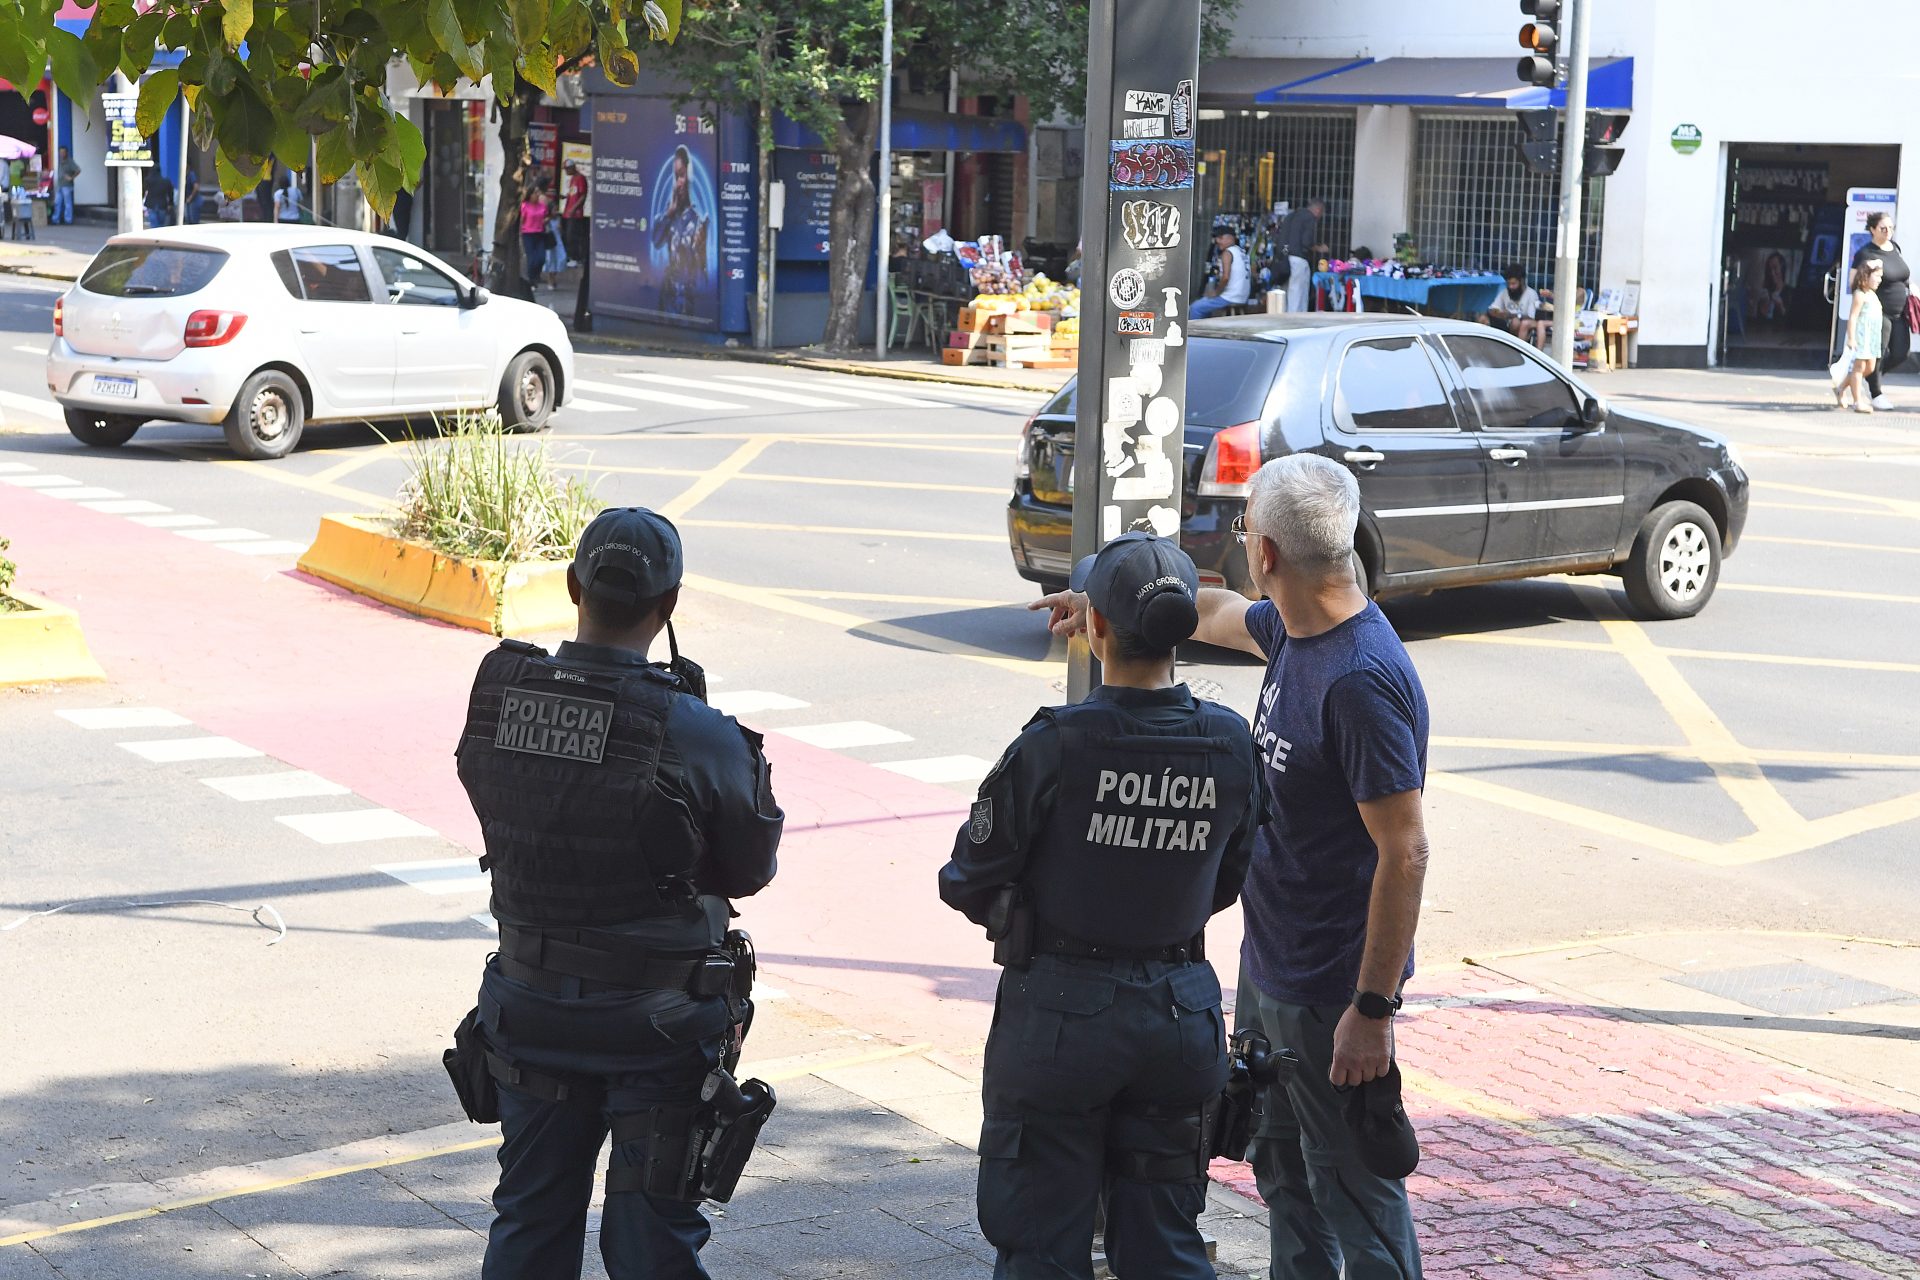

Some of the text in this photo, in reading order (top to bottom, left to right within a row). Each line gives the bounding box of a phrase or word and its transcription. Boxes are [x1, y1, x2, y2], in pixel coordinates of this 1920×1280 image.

[1677, 125, 1697, 136] MS
[731, 162, 750, 173] TIM
[744, 192, 751, 200] A
[588, 543, 651, 567] MATO GROSSO DO SUL
[1136, 582, 1155, 600] MATO
[1155, 576, 1180, 586] GROSSO
[503, 697, 604, 733] POLÍCIA
[499, 721, 601, 759] MILITAR
[1095, 767, 1217, 809] POLÍCIA
[1086, 812, 1211, 851] MILITAR
